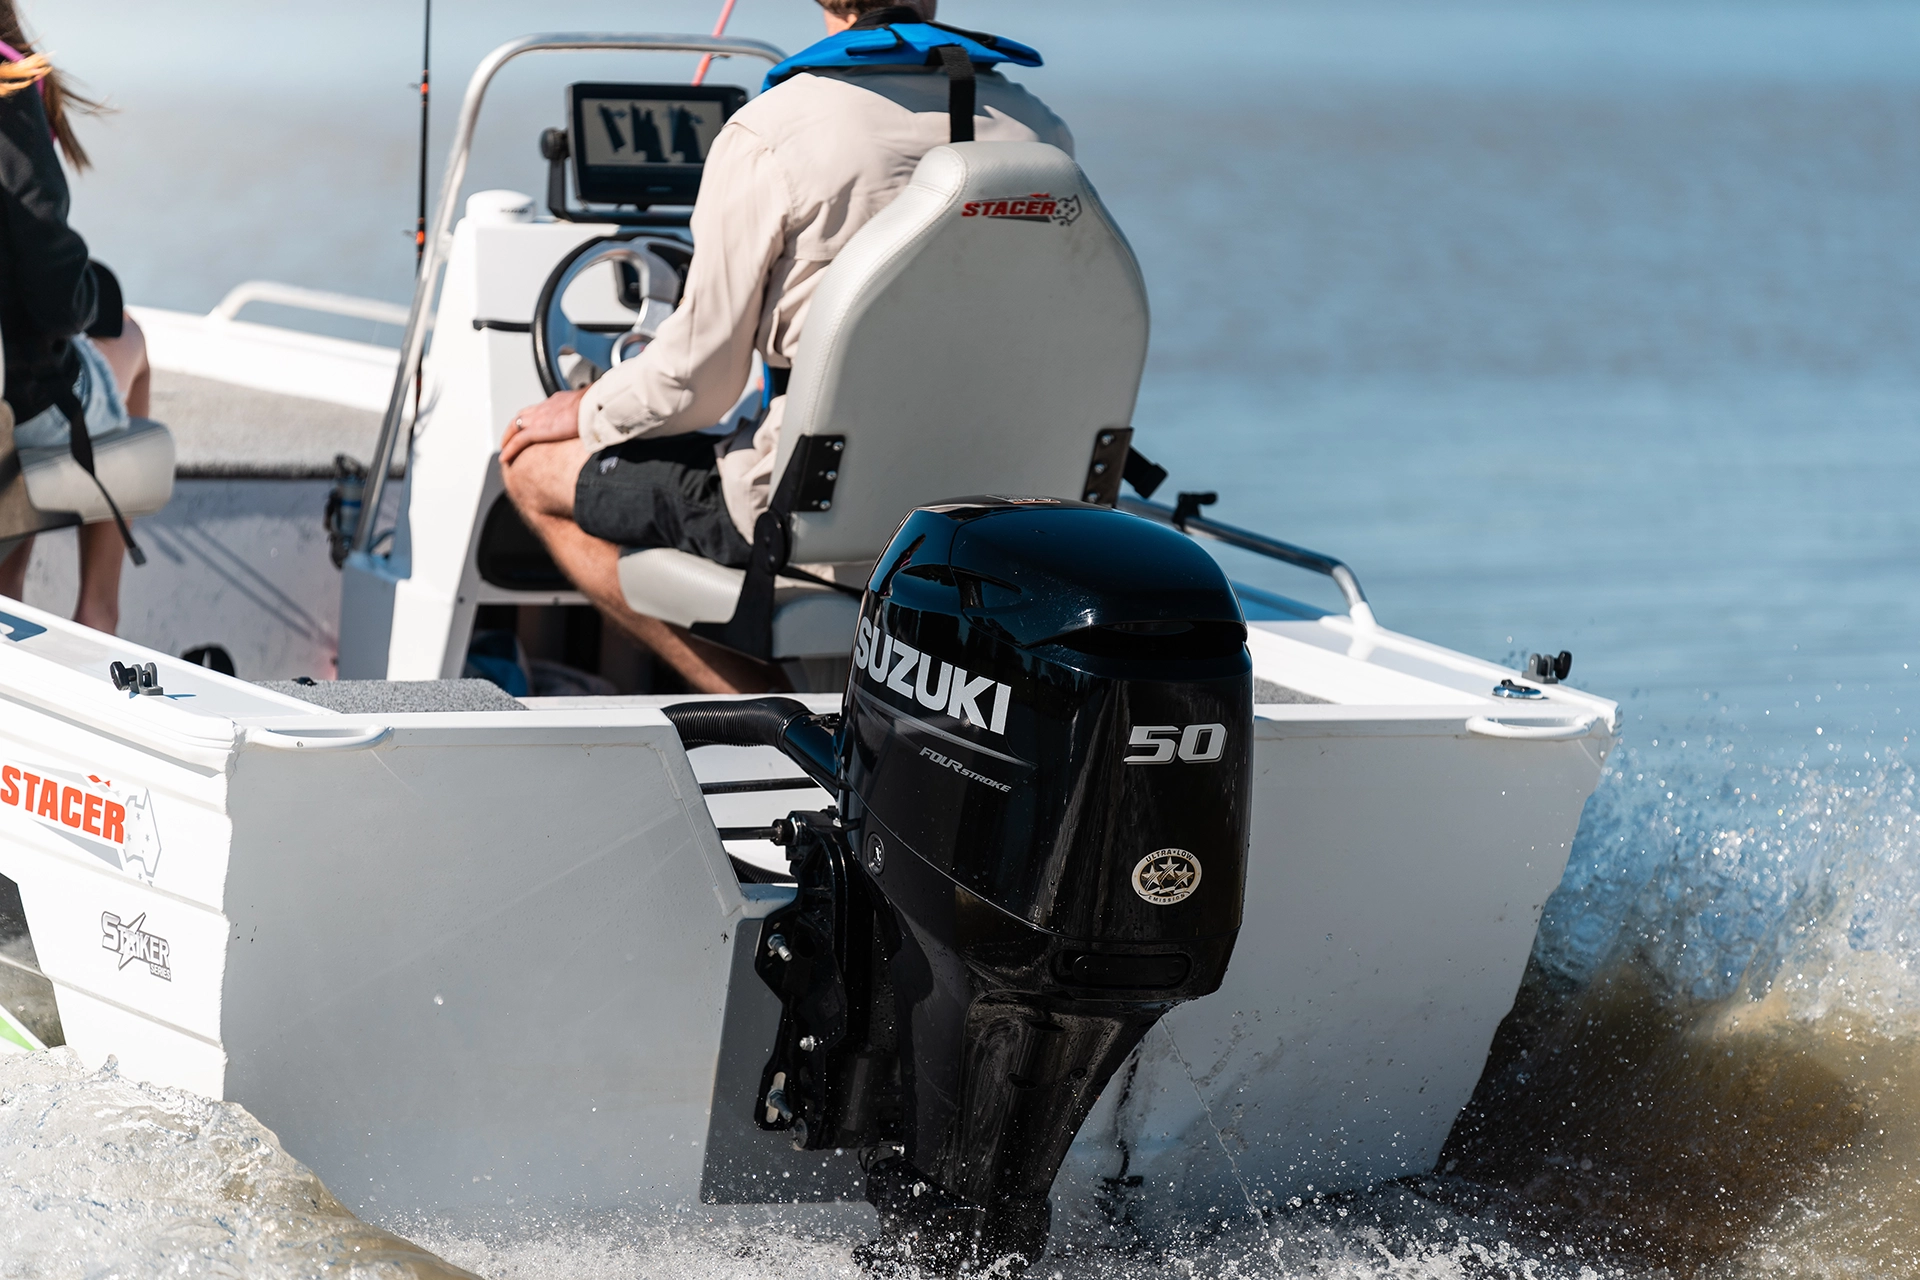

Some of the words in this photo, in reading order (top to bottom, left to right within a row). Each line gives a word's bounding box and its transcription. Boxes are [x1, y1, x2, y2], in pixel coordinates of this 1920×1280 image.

[961, 201, 1057, 217] STACER
[855, 616, 1012, 736] SUZUKI
[1123, 723, 1228, 765] 50
[0, 765, 126, 844] STACER
[1148, 893, 1186, 903] EMISSION
[150, 963, 172, 981] SERIES
